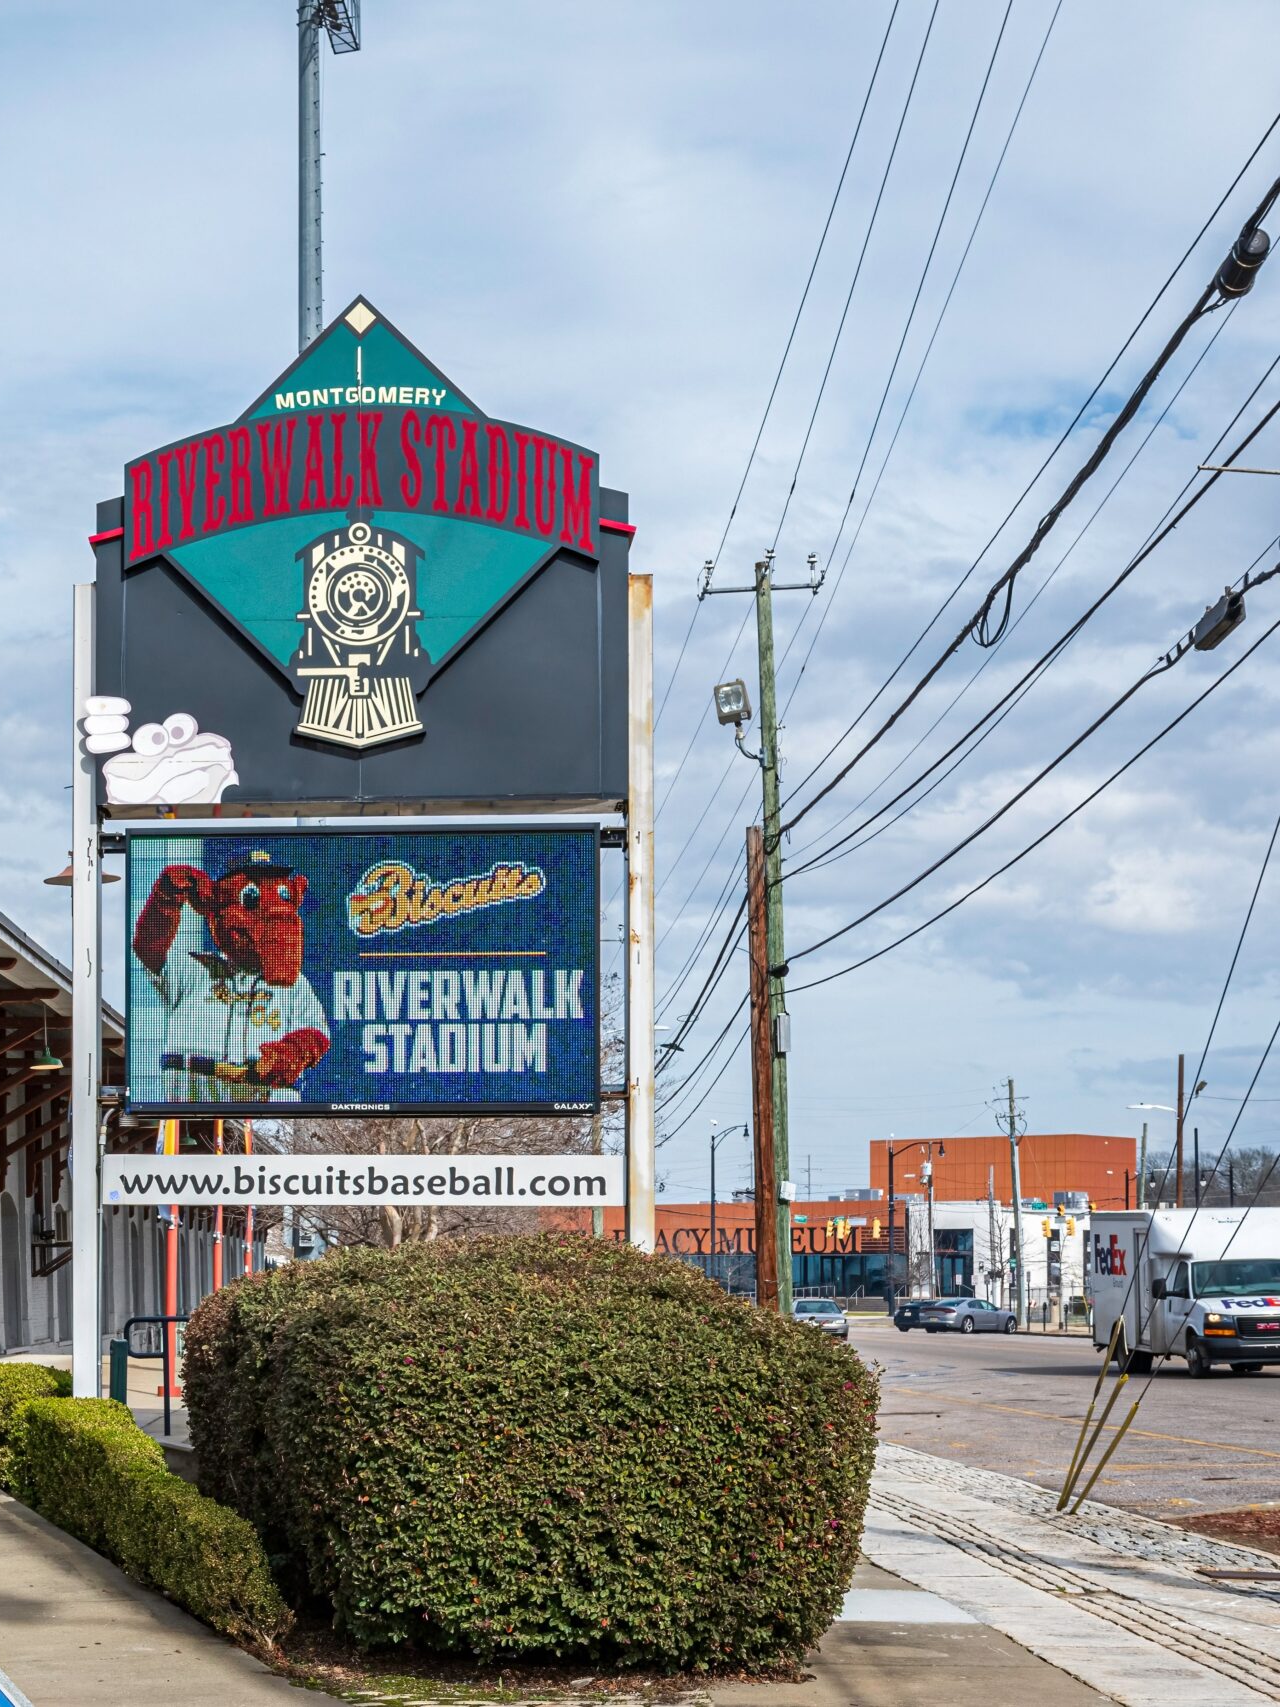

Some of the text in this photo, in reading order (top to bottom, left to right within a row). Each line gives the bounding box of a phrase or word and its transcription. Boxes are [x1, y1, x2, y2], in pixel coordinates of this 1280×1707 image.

[275, 387, 447, 409] MONTGOMERY
[129, 409, 596, 562] RIVERWALK STADIUM
[349, 862, 545, 936] Biscuits
[333, 970, 585, 1020] RIVERWALK
[364, 1024, 546, 1072] STADIUM
[331, 1103, 390, 1111] DAKTRONICS
[553, 1102, 593, 1111] GALAXY
[120, 1166, 607, 1196] www.biscuitsbaseball.com
[1094, 1233, 1127, 1276] FedEx
[1221, 1297, 1280, 1309] FedE
